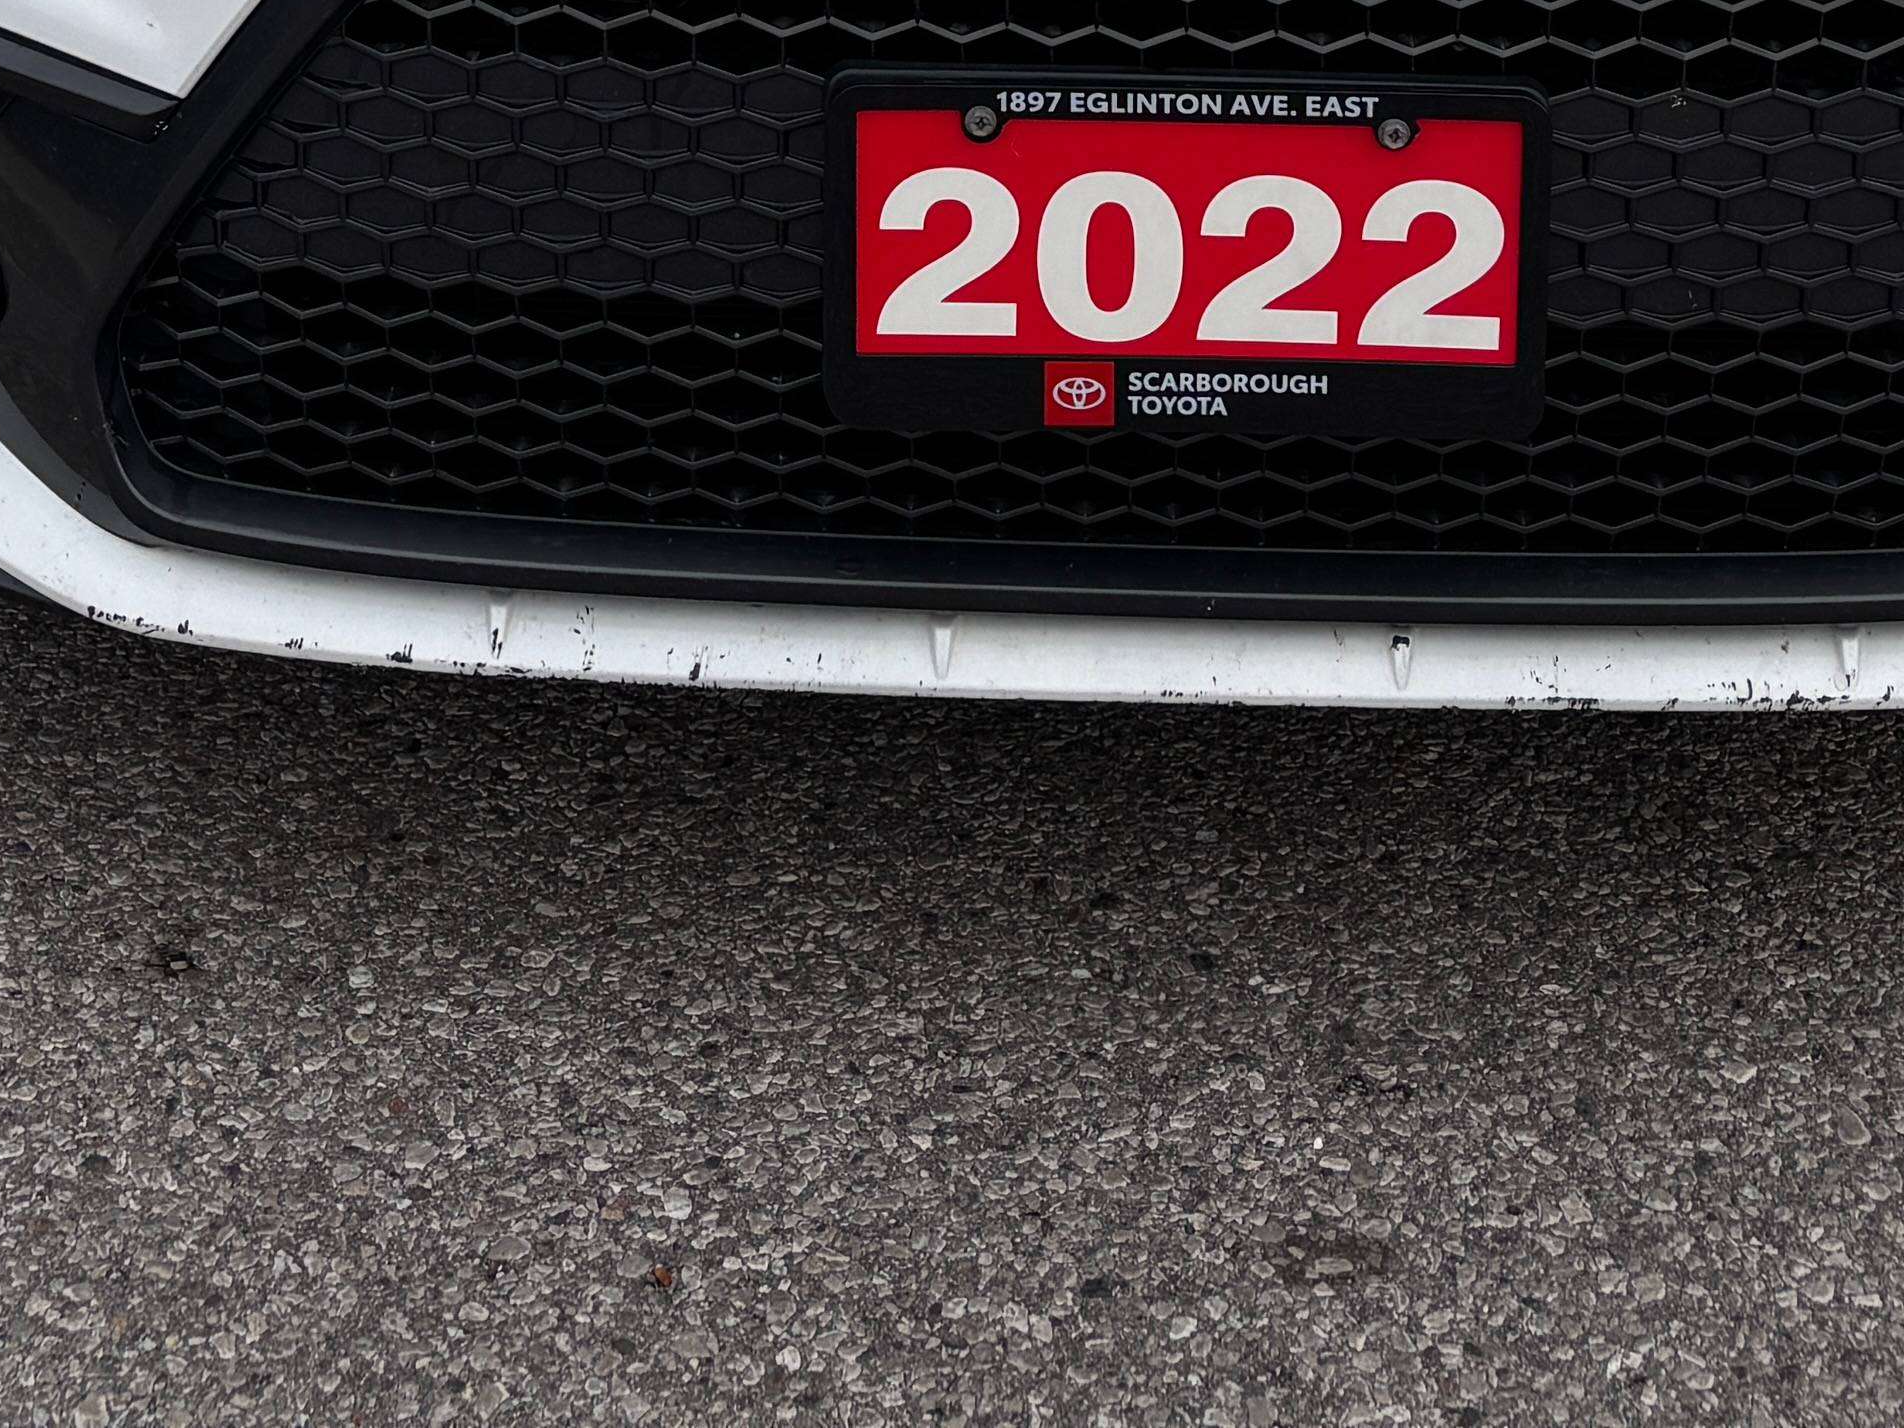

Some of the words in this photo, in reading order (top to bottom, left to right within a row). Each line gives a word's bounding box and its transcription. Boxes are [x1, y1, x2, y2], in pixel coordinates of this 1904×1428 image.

[996, 91, 1061, 113] 1897
[1070, 92, 1223, 116] EGLINTON
[1230, 94, 1297, 117] AVE.
[1305, 95, 1380, 119] EAST
[876, 166, 1505, 351] 2022
[1128, 372, 1329, 395] SCARBOROUGH
[1127, 395, 1228, 416] TOYOTA
